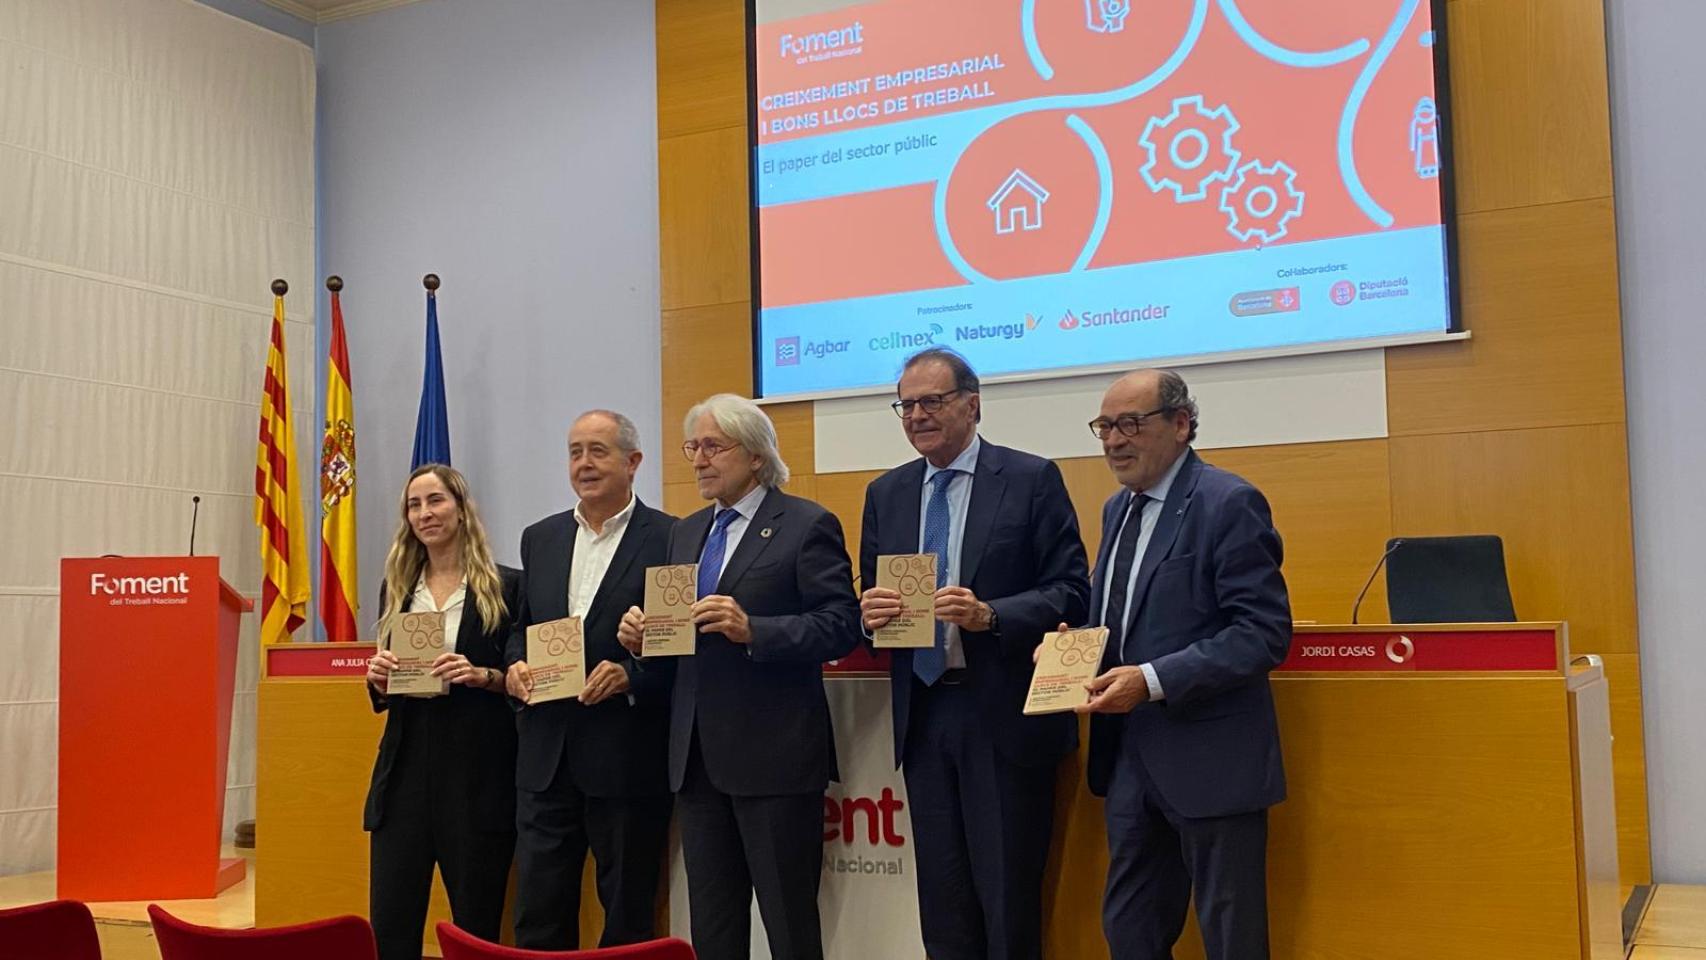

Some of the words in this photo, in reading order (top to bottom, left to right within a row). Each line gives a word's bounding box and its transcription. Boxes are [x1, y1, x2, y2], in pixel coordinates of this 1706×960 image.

[780, 22, 863, 57] Foment
[760, 78, 871, 111] CREIXEMENT
[875, 54, 1005, 91] EMPRESARIAL
[761, 121, 768, 136] I
[772, 111, 819, 134] BONS
[823, 102, 879, 126] LLOCS
[883, 96, 909, 115] DE
[912, 81, 995, 109] TREBALL
[763, 160, 774, 174] El
[778, 154, 818, 175] paper
[822, 148, 842, 165] del
[846, 142, 891, 161] sector
[894, 134, 938, 157] públic
[1359, 276, 1408, 290] Diputació
[1359, 288, 1409, 301] Barcelona
[1081, 303, 1171, 328] Santander
[869, 329, 934, 351] cellnex
[955, 321, 1024, 343] Naturgy
[805, 338, 850, 359] Agbar
[91, 573, 189, 595] Foment
[109, 598, 123, 606] del
[152, 597, 187, 605] Nacional
[1301, 646, 1336, 657] JORDI
[1338, 646, 1375, 657] CASAS
[331, 658, 346, 668] ANA
[346, 658, 365, 667] JULIA
[823, 787, 905, 848] ent
